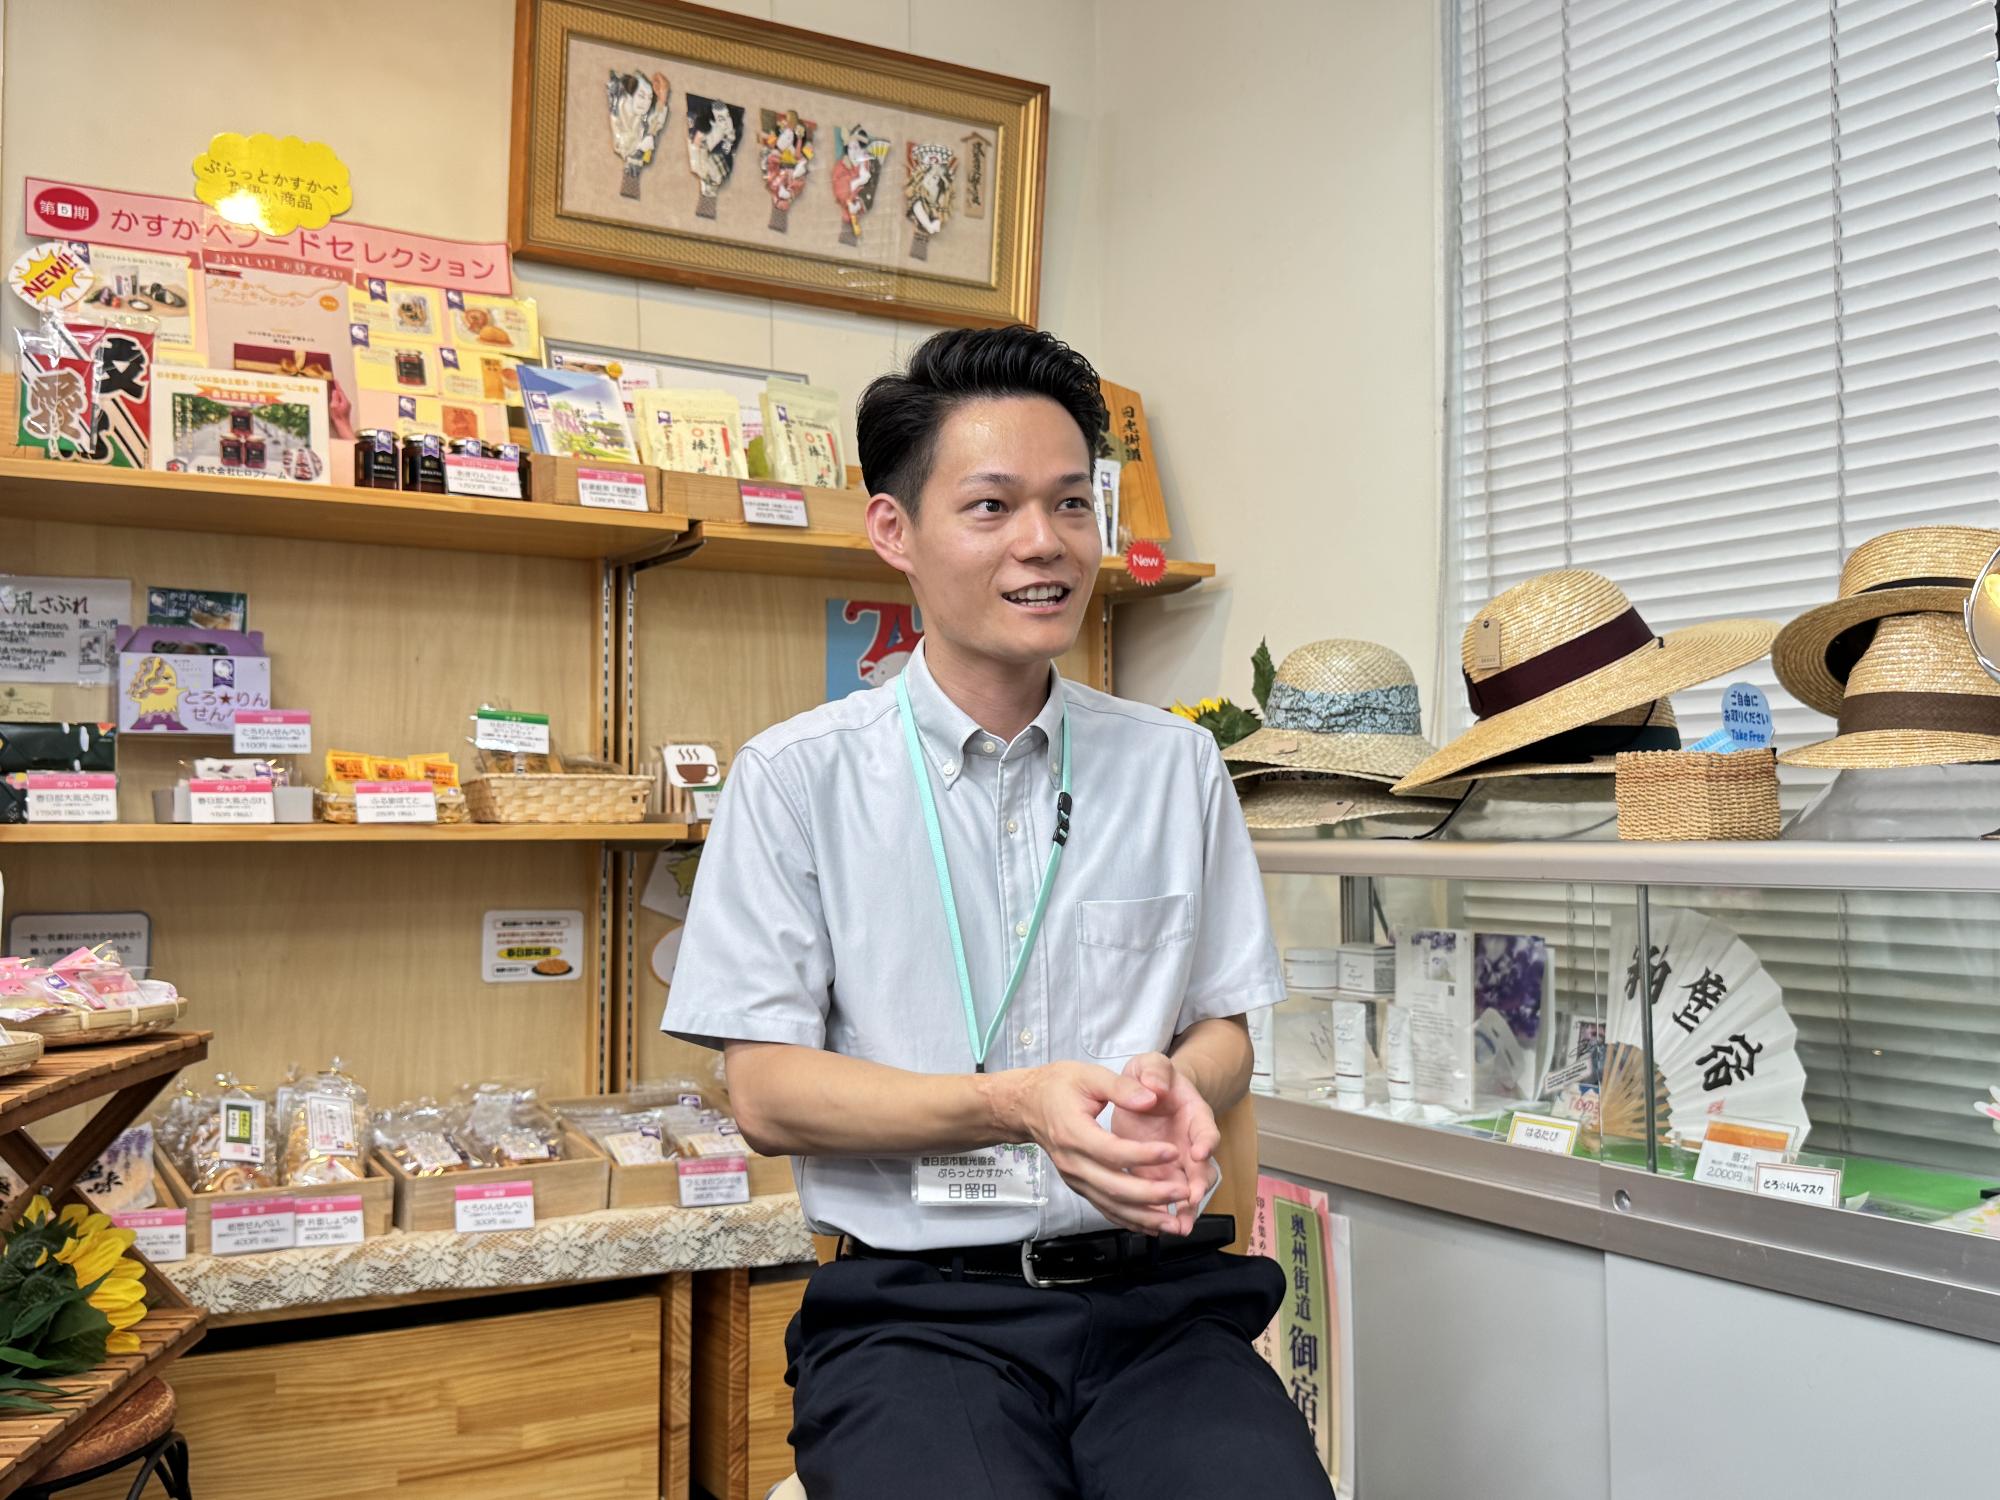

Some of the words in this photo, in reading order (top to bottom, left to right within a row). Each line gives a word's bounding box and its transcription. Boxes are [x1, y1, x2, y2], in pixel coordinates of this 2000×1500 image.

[204, 160, 339, 196] ぷらっとかすかべ
[111, 209, 495, 280] かすかべフードセレクション
[22, 253, 78, 298] NEW!!
[1132, 554, 1160, 568] New
[0, 591, 89, 616] 凧さぶれ
[1730, 690, 1759, 707] ご自由に
[192, 706, 234, 722] せん
[1723, 709, 1769, 725] お取りください
[1731, 729, 1748, 742] Take
[1749, 729, 1766, 743] Free
[1525, 1126, 1559, 1142] はるたび
[921, 1156, 996, 1166] 春日部市観光協会
[937, 1168, 1014, 1178] ぷらっとかすかべ
[949, 1183, 997, 1199] 日留田
[1289, 1213, 1312, 1322] 奥州街道
[1288, 1324, 1319, 1453] 御宿
